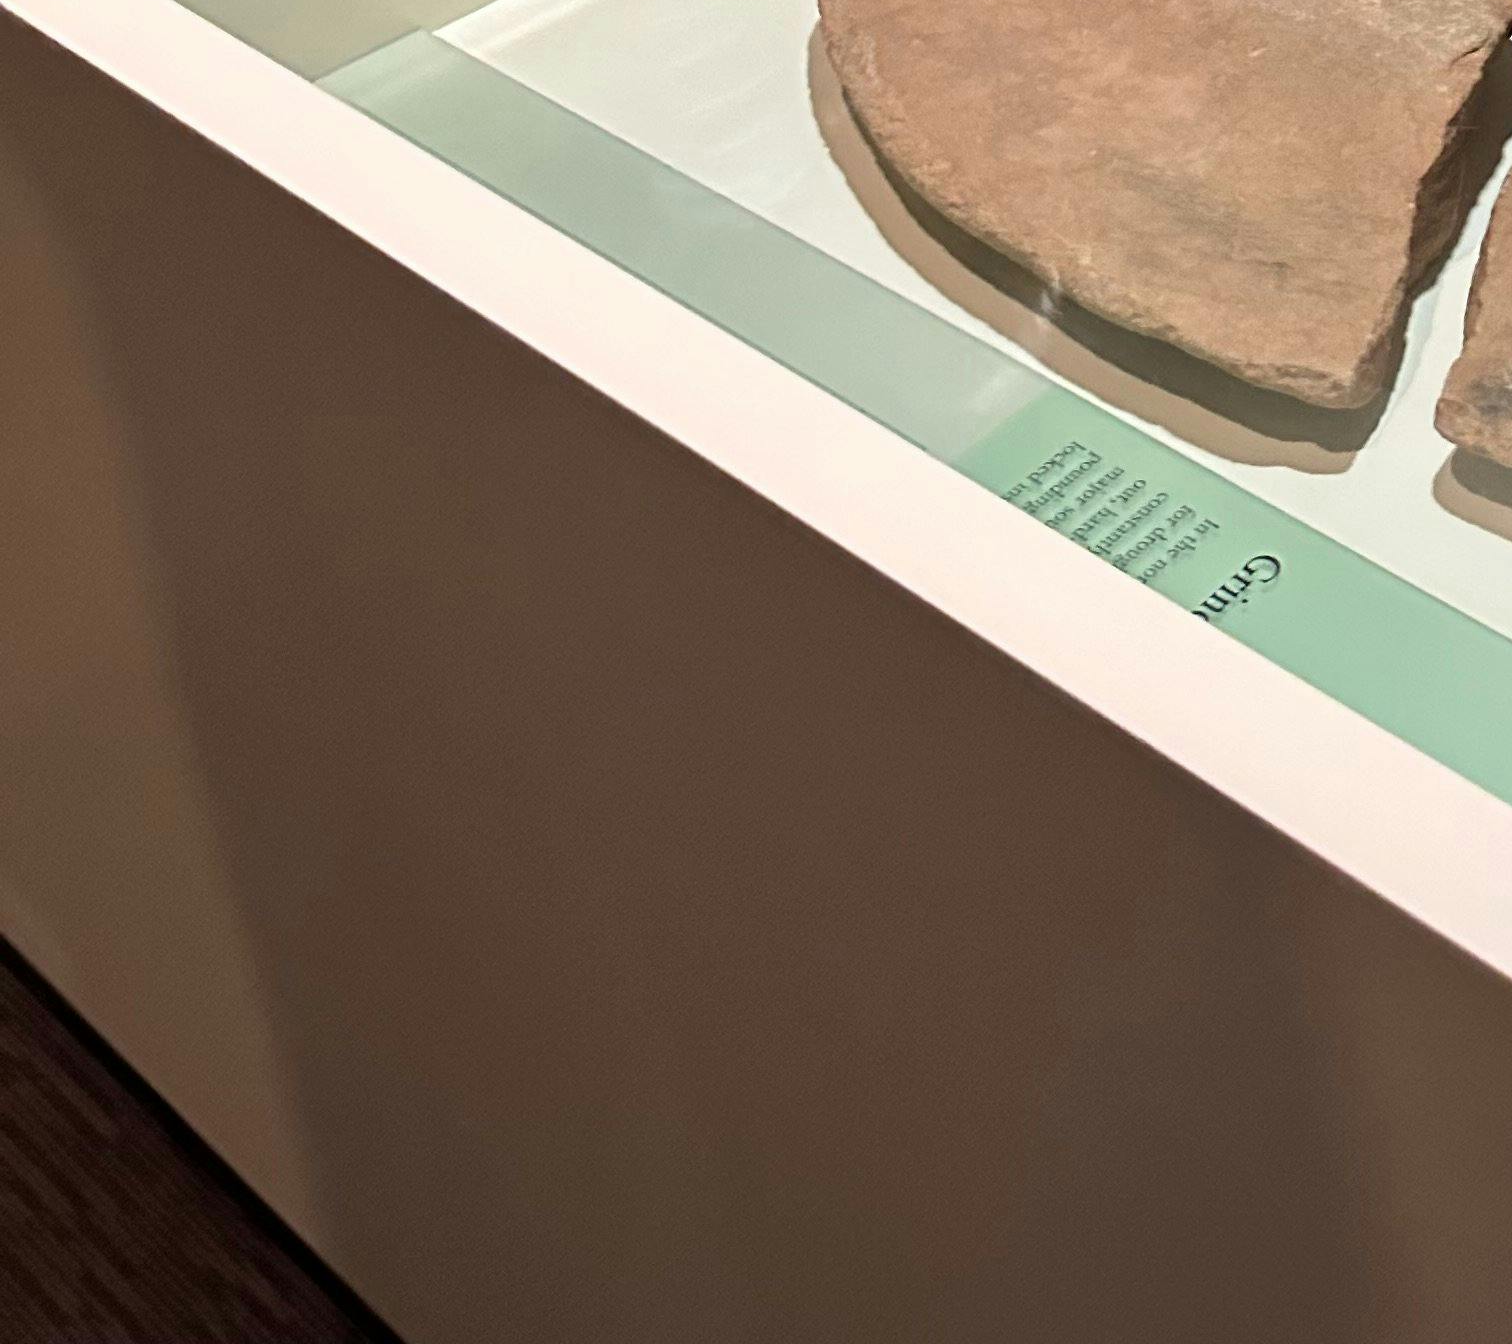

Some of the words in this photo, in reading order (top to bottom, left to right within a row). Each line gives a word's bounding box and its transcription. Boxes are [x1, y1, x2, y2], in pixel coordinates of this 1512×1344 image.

[1025, 441, 1087, 486] locked
[1021, 451, 1102, 514] pounding
[1075, 467, 1125, 505] major
[1109, 479, 1147, 504] out,
[1166, 504, 1197, 528] for
[1193, 518, 1220, 535] In
[1166, 534, 1197, 559] the
